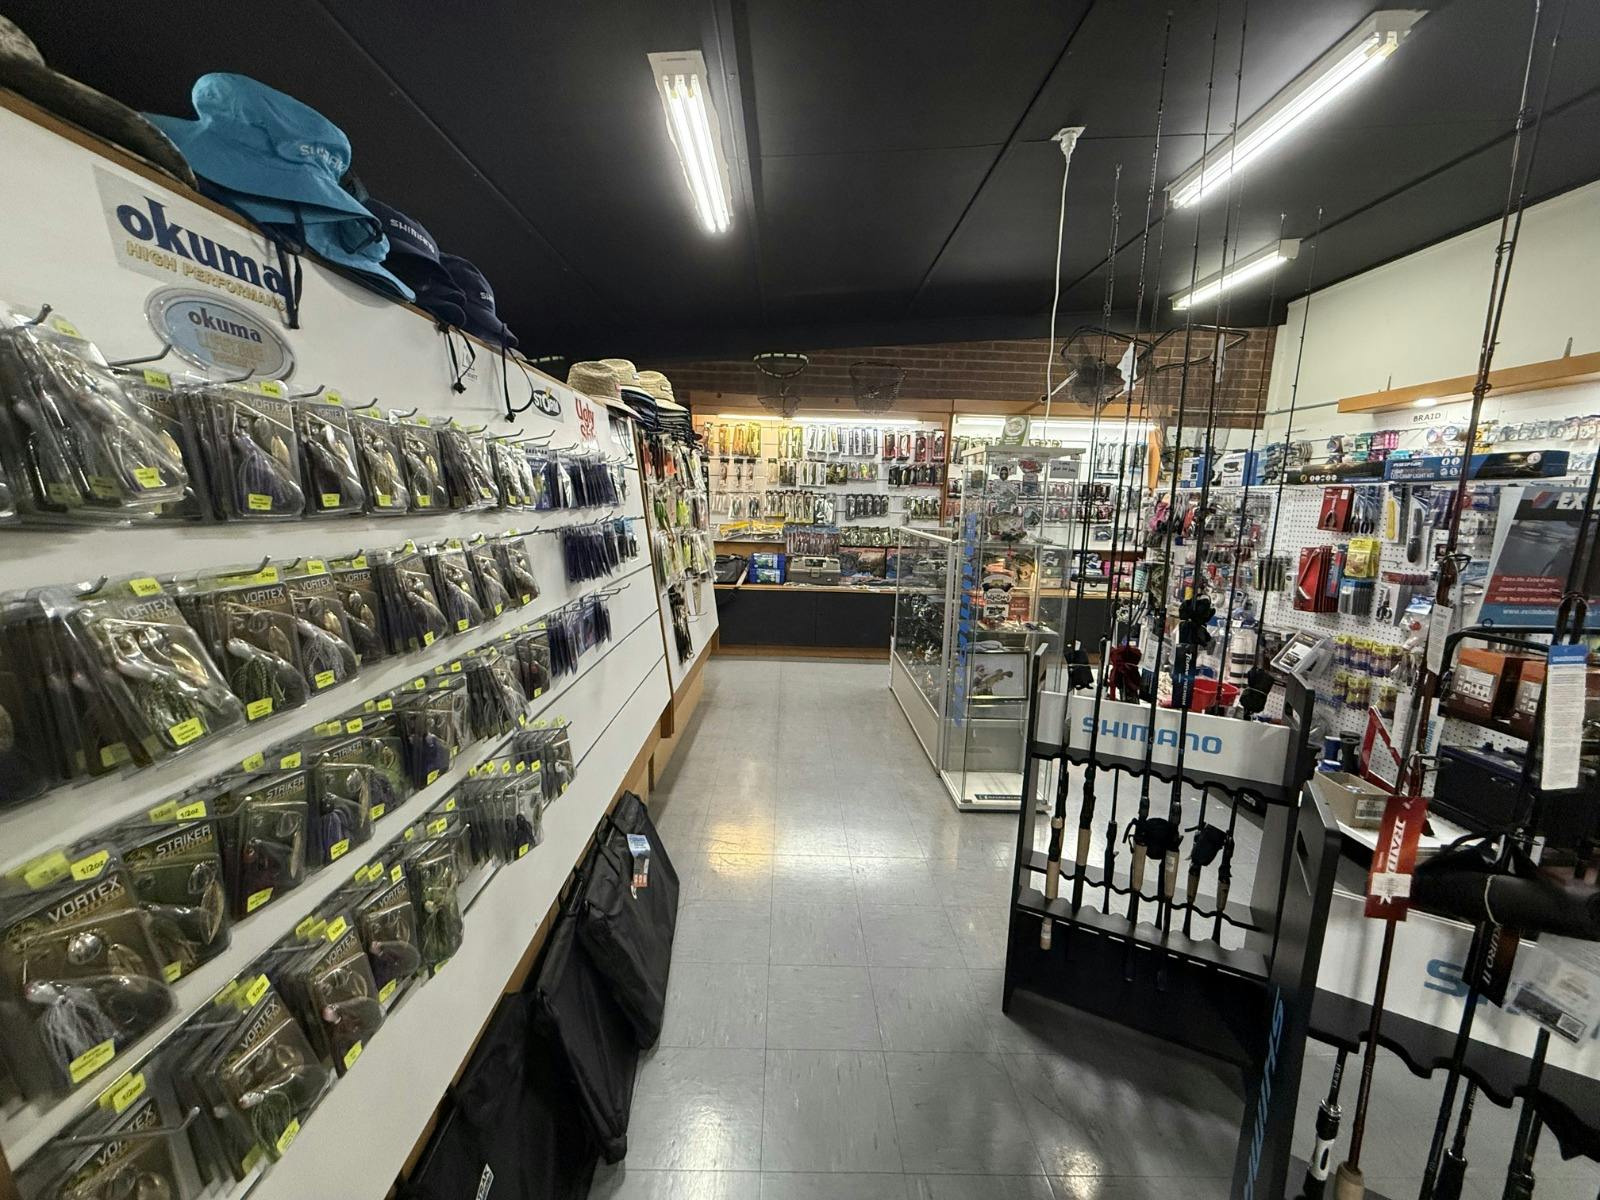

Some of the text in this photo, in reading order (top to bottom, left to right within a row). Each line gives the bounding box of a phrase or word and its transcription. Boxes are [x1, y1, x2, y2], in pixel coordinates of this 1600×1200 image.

[116, 195, 288, 299] okuma
[126, 239, 287, 314] HIGH PERFORMANC
[187, 306, 263, 344] okuma
[574, 397, 595, 431] Ugly
[1412, 412, 1442, 422] BRAID
[300, 577, 331, 591] VORTEX
[343, 570, 371, 582] VORTEX
[242, 586, 285, 603] VORTEX
[119, 598, 170, 620] VORTEX
[332, 740, 363, 759] STRIKER
[1082, 716, 1223, 755] SHIMANO
[266, 776, 305, 800] STRIKER
[180, 808, 199, 818] 1/2oz
[155, 824, 211, 856] STRIKER
[81, 860, 104, 875] 1/2oz
[48, 875, 121, 922] VORTEX
[379, 880, 407, 908] VORTEX
[326, 930, 358, 964] VORTEX
[240, 998, 280, 1049] VORTEX
